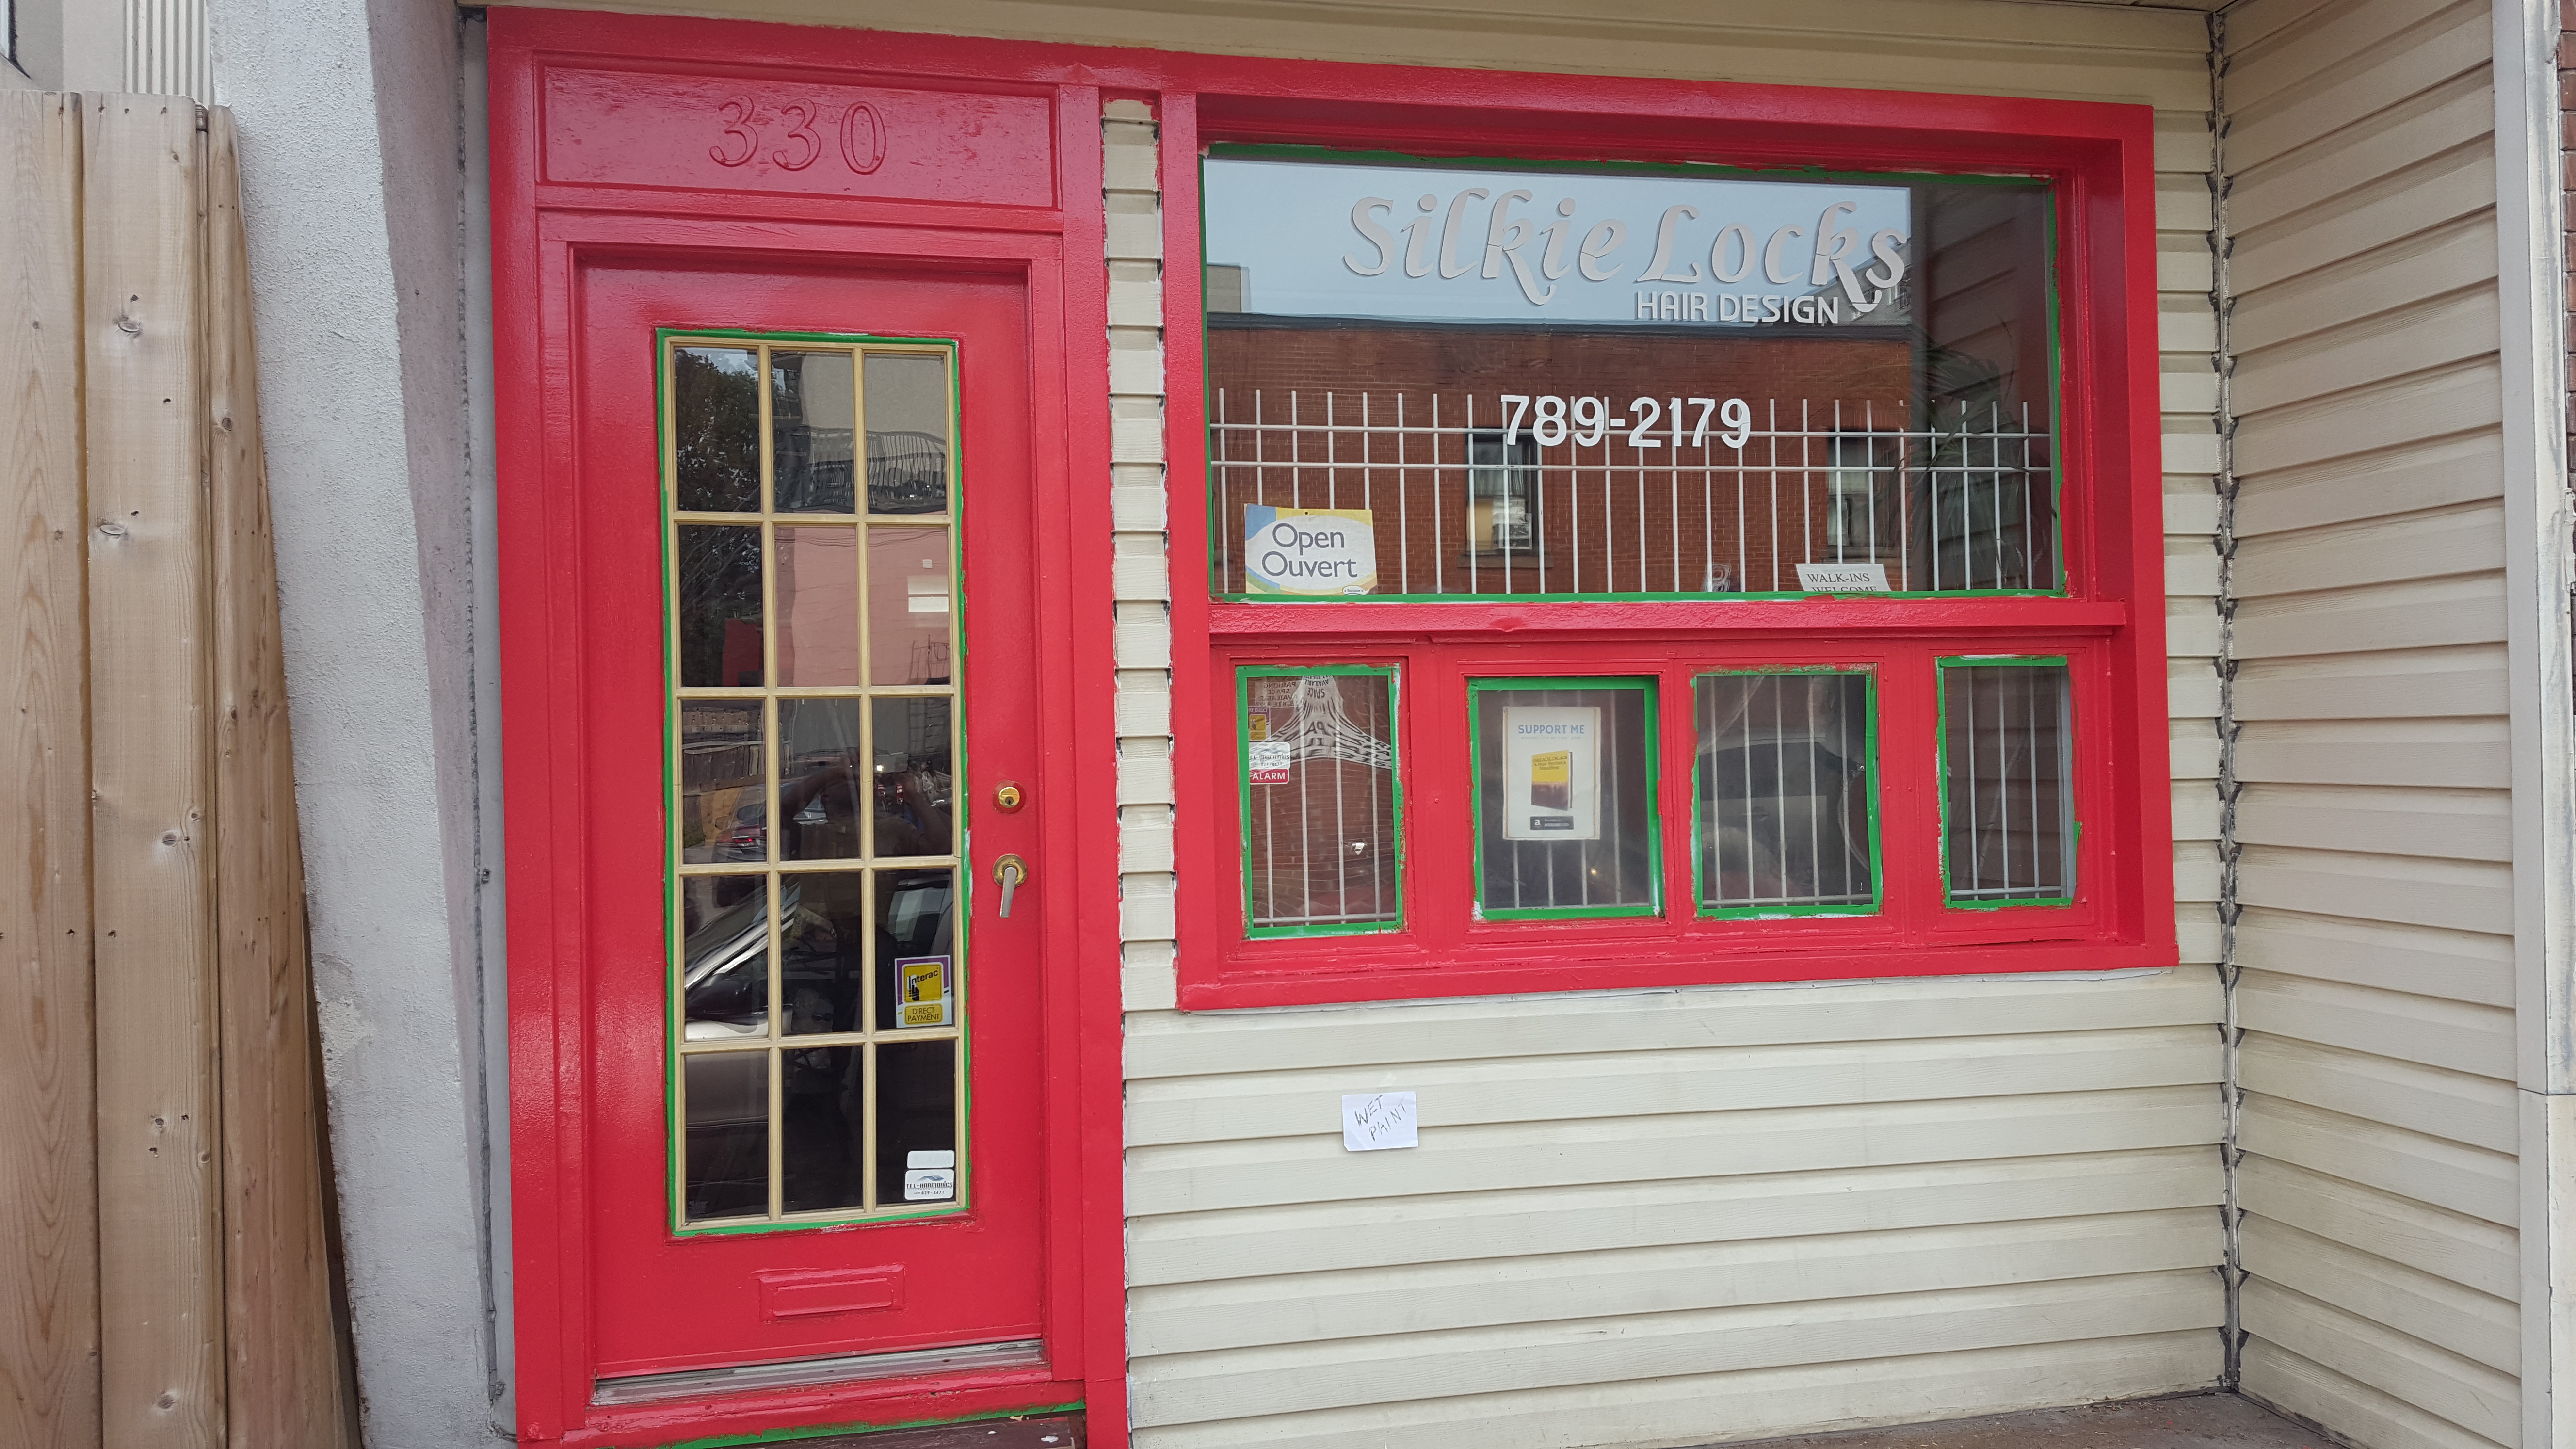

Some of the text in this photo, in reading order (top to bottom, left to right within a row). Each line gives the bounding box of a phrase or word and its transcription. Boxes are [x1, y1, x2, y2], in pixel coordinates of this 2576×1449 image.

[708, 94, 887, 175] 330
[1342, 187, 1908, 313] Silkie Locks
[1635, 290, 1839, 324] HAIR DESIGN
[1500, 394, 1751, 449] 789-2179
[1272, 522, 1345, 556] Open
[1262, 551, 1358, 578] Ouvert
[1806, 573, 1870, 582] WALK-INS
[1518, 724, 1585, 734] SUPPORT ME
[908, 969, 939, 990] Interac
[907, 1013, 940, 1022] PAYMENT
[1354, 1094, 1384, 1126] WET
[1369, 1096, 1407, 1142] PAINT
